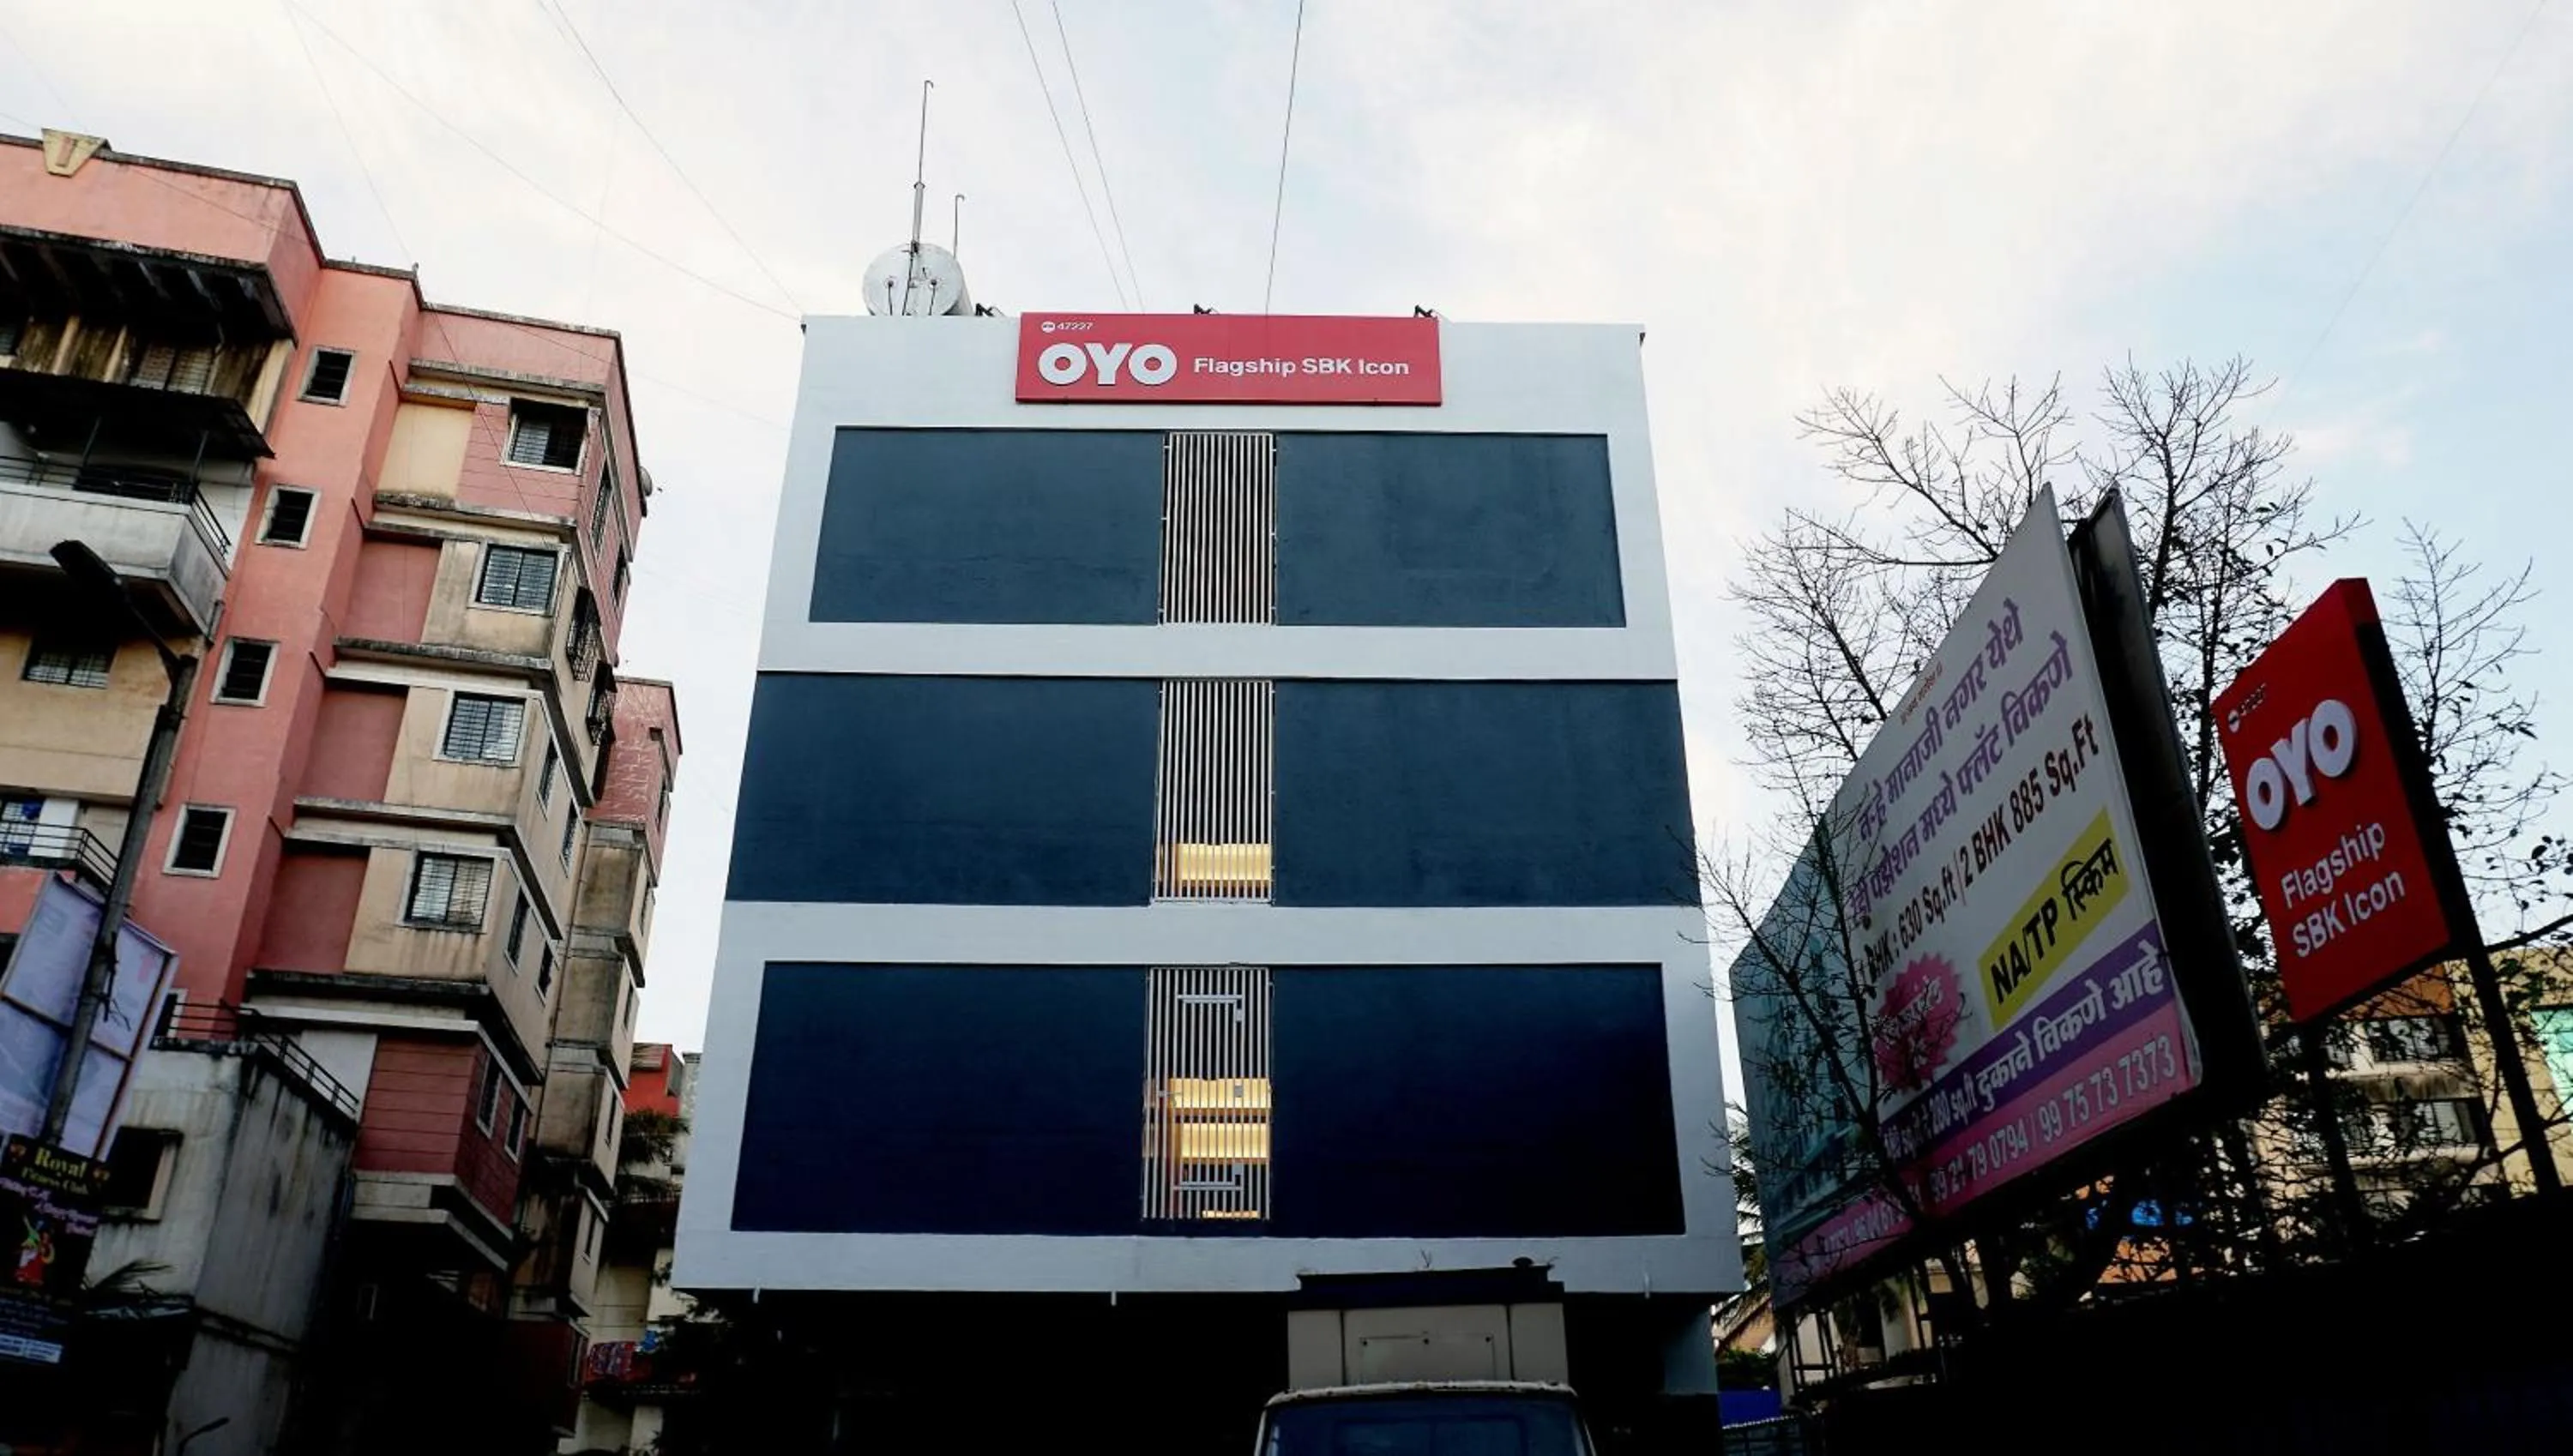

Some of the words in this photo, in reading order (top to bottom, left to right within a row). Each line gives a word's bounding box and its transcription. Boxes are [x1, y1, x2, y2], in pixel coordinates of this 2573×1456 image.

[1038, 342, 1178, 387] OYO
[1194, 357, 1296, 378] Flagship
[1302, 358, 1351, 375] SBK
[1358, 358, 1410, 376] Icon
[1943, 653, 1988, 731] नगर
[1986, 596, 2025, 671] येथे
[1919, 770, 1957, 842] मध्ये
[2000, 629, 2073, 749] विकणे
[2245, 698, 2359, 832] OYO
[1898, 897, 1924, 952] 630
[1922, 863, 1958, 924] Sq.ft
[1960, 845, 1973, 888] 2
[1972, 803, 2012, 875] BHK
[2010, 767, 2046, 834] 885
[2045, 712, 2100, 798] Sq.Ft
[2280, 821, 2388, 910] Flagship
[1990, 897, 2060, 1005] NA/TP
[2292, 899, 2347, 960] SBK
[2345, 869, 2407, 927] Icon
[1975, 1030, 2034, 1114] दुकाने
[2033, 983, 2111, 1065] विकणे
[2109, 937, 2166, 1013] आहे
[1966, 1141, 1989, 1181] 79
[1988, 1117, 2030, 1170] 0794
[2038, 1105, 2064, 1145] 99
[2064, 1088, 2091, 1130] 75
[2089, 1072, 2117, 1115] 73
[2118, 1034, 2178, 1100] 7373
